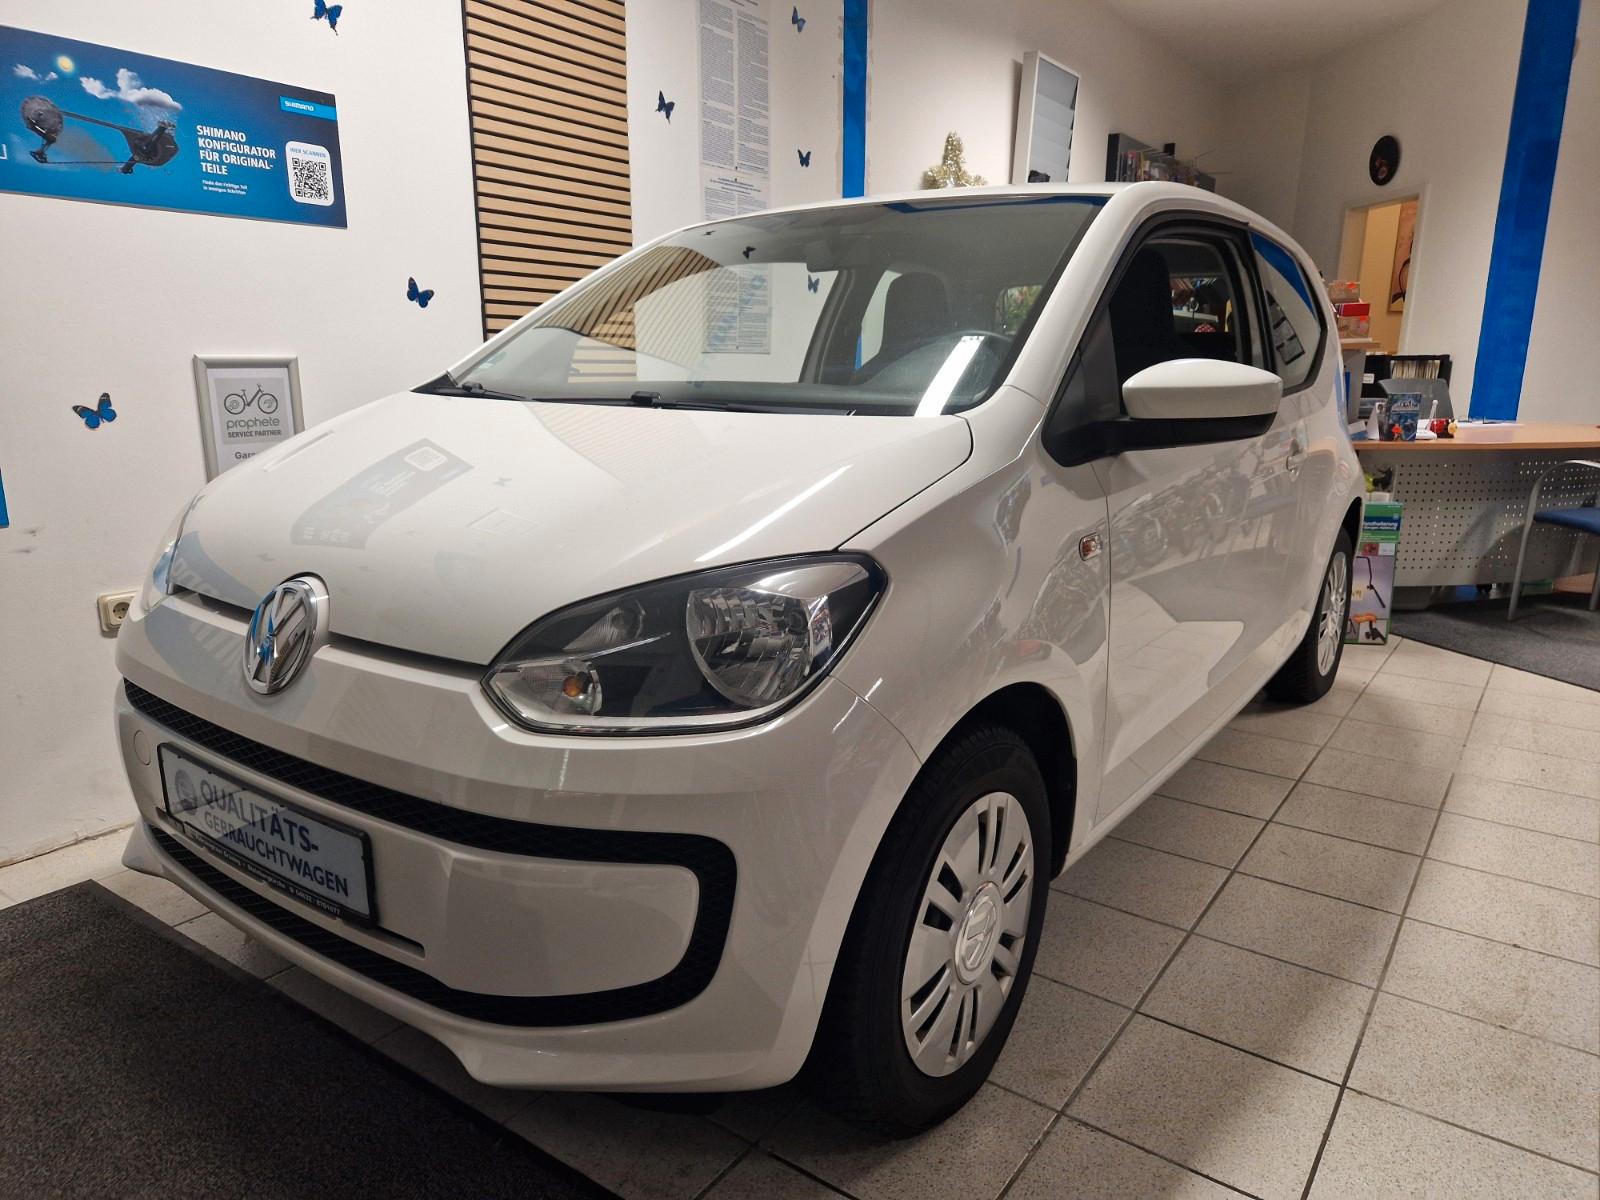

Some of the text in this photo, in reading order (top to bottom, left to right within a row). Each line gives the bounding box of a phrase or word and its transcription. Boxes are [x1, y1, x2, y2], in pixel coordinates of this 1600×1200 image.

[197, 125, 246, 142] SHIMANO
[198, 138, 276, 159] KONFIGURATOR
[199, 149, 274, 170] FÜR ORIGINAL-
[201, 162, 228, 175] TEILE
[226, 417, 280, 430] prophete
[199, 777, 320, 852] QUALITÄTS-
[203, 810, 349, 898] GEBRAUCHTWAGEN
